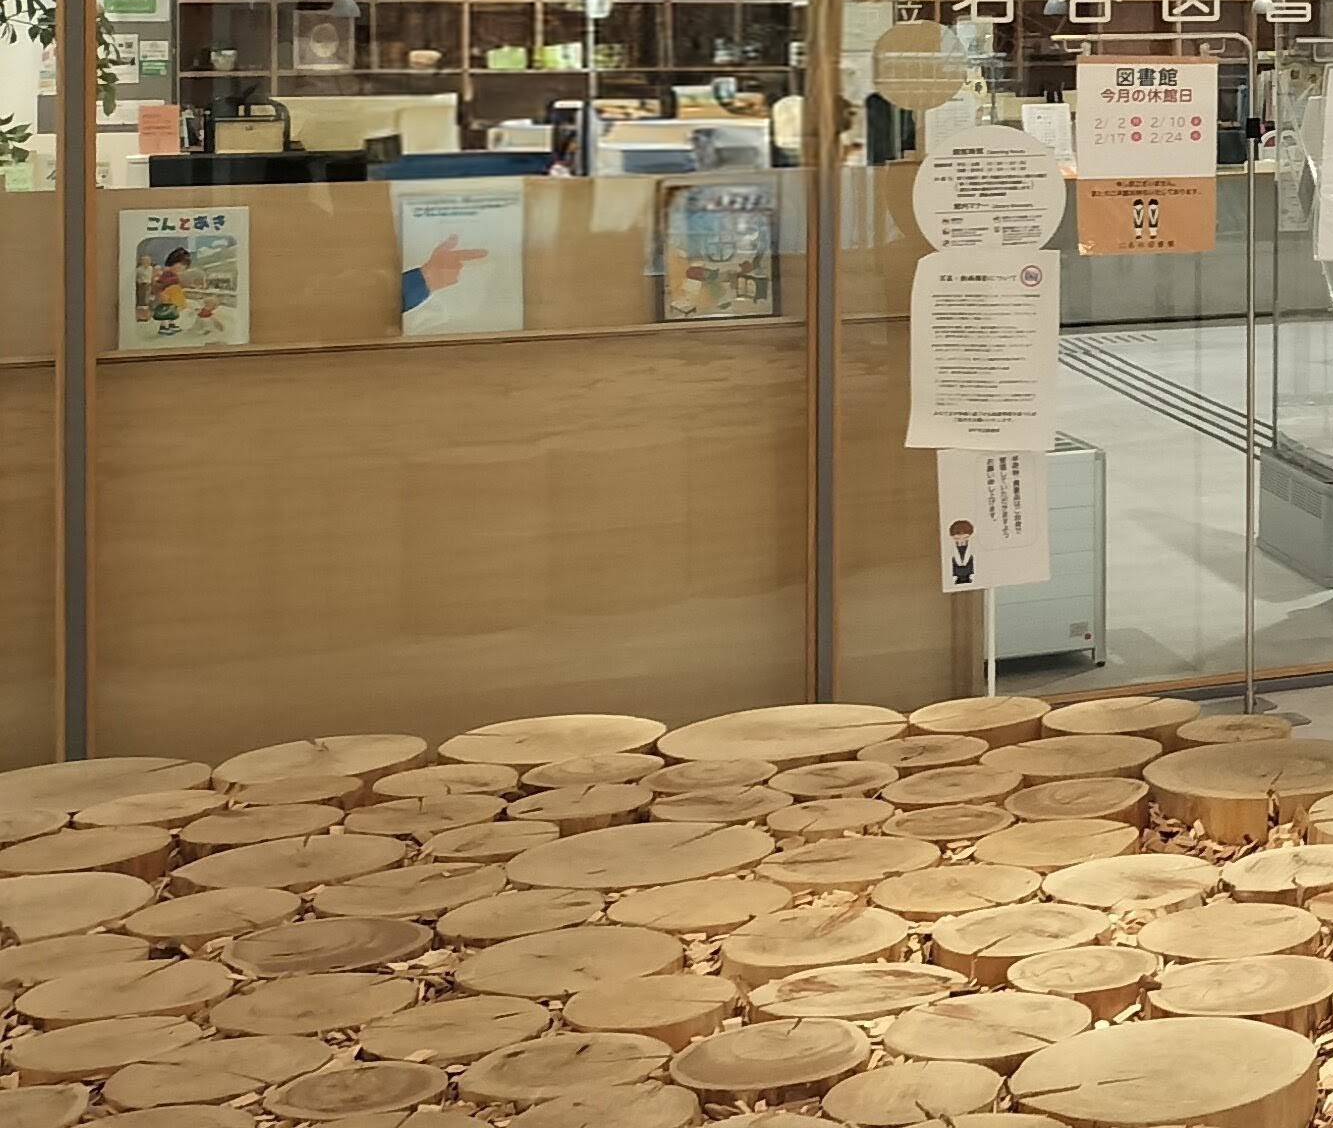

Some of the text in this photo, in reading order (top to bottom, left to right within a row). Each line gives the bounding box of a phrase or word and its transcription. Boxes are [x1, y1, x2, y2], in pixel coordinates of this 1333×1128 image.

[1116, 67, 1178, 87] 図書館
[1100, 88, 1192, 104] 今月の休館日
[147, 215, 226, 231] こんとあき
